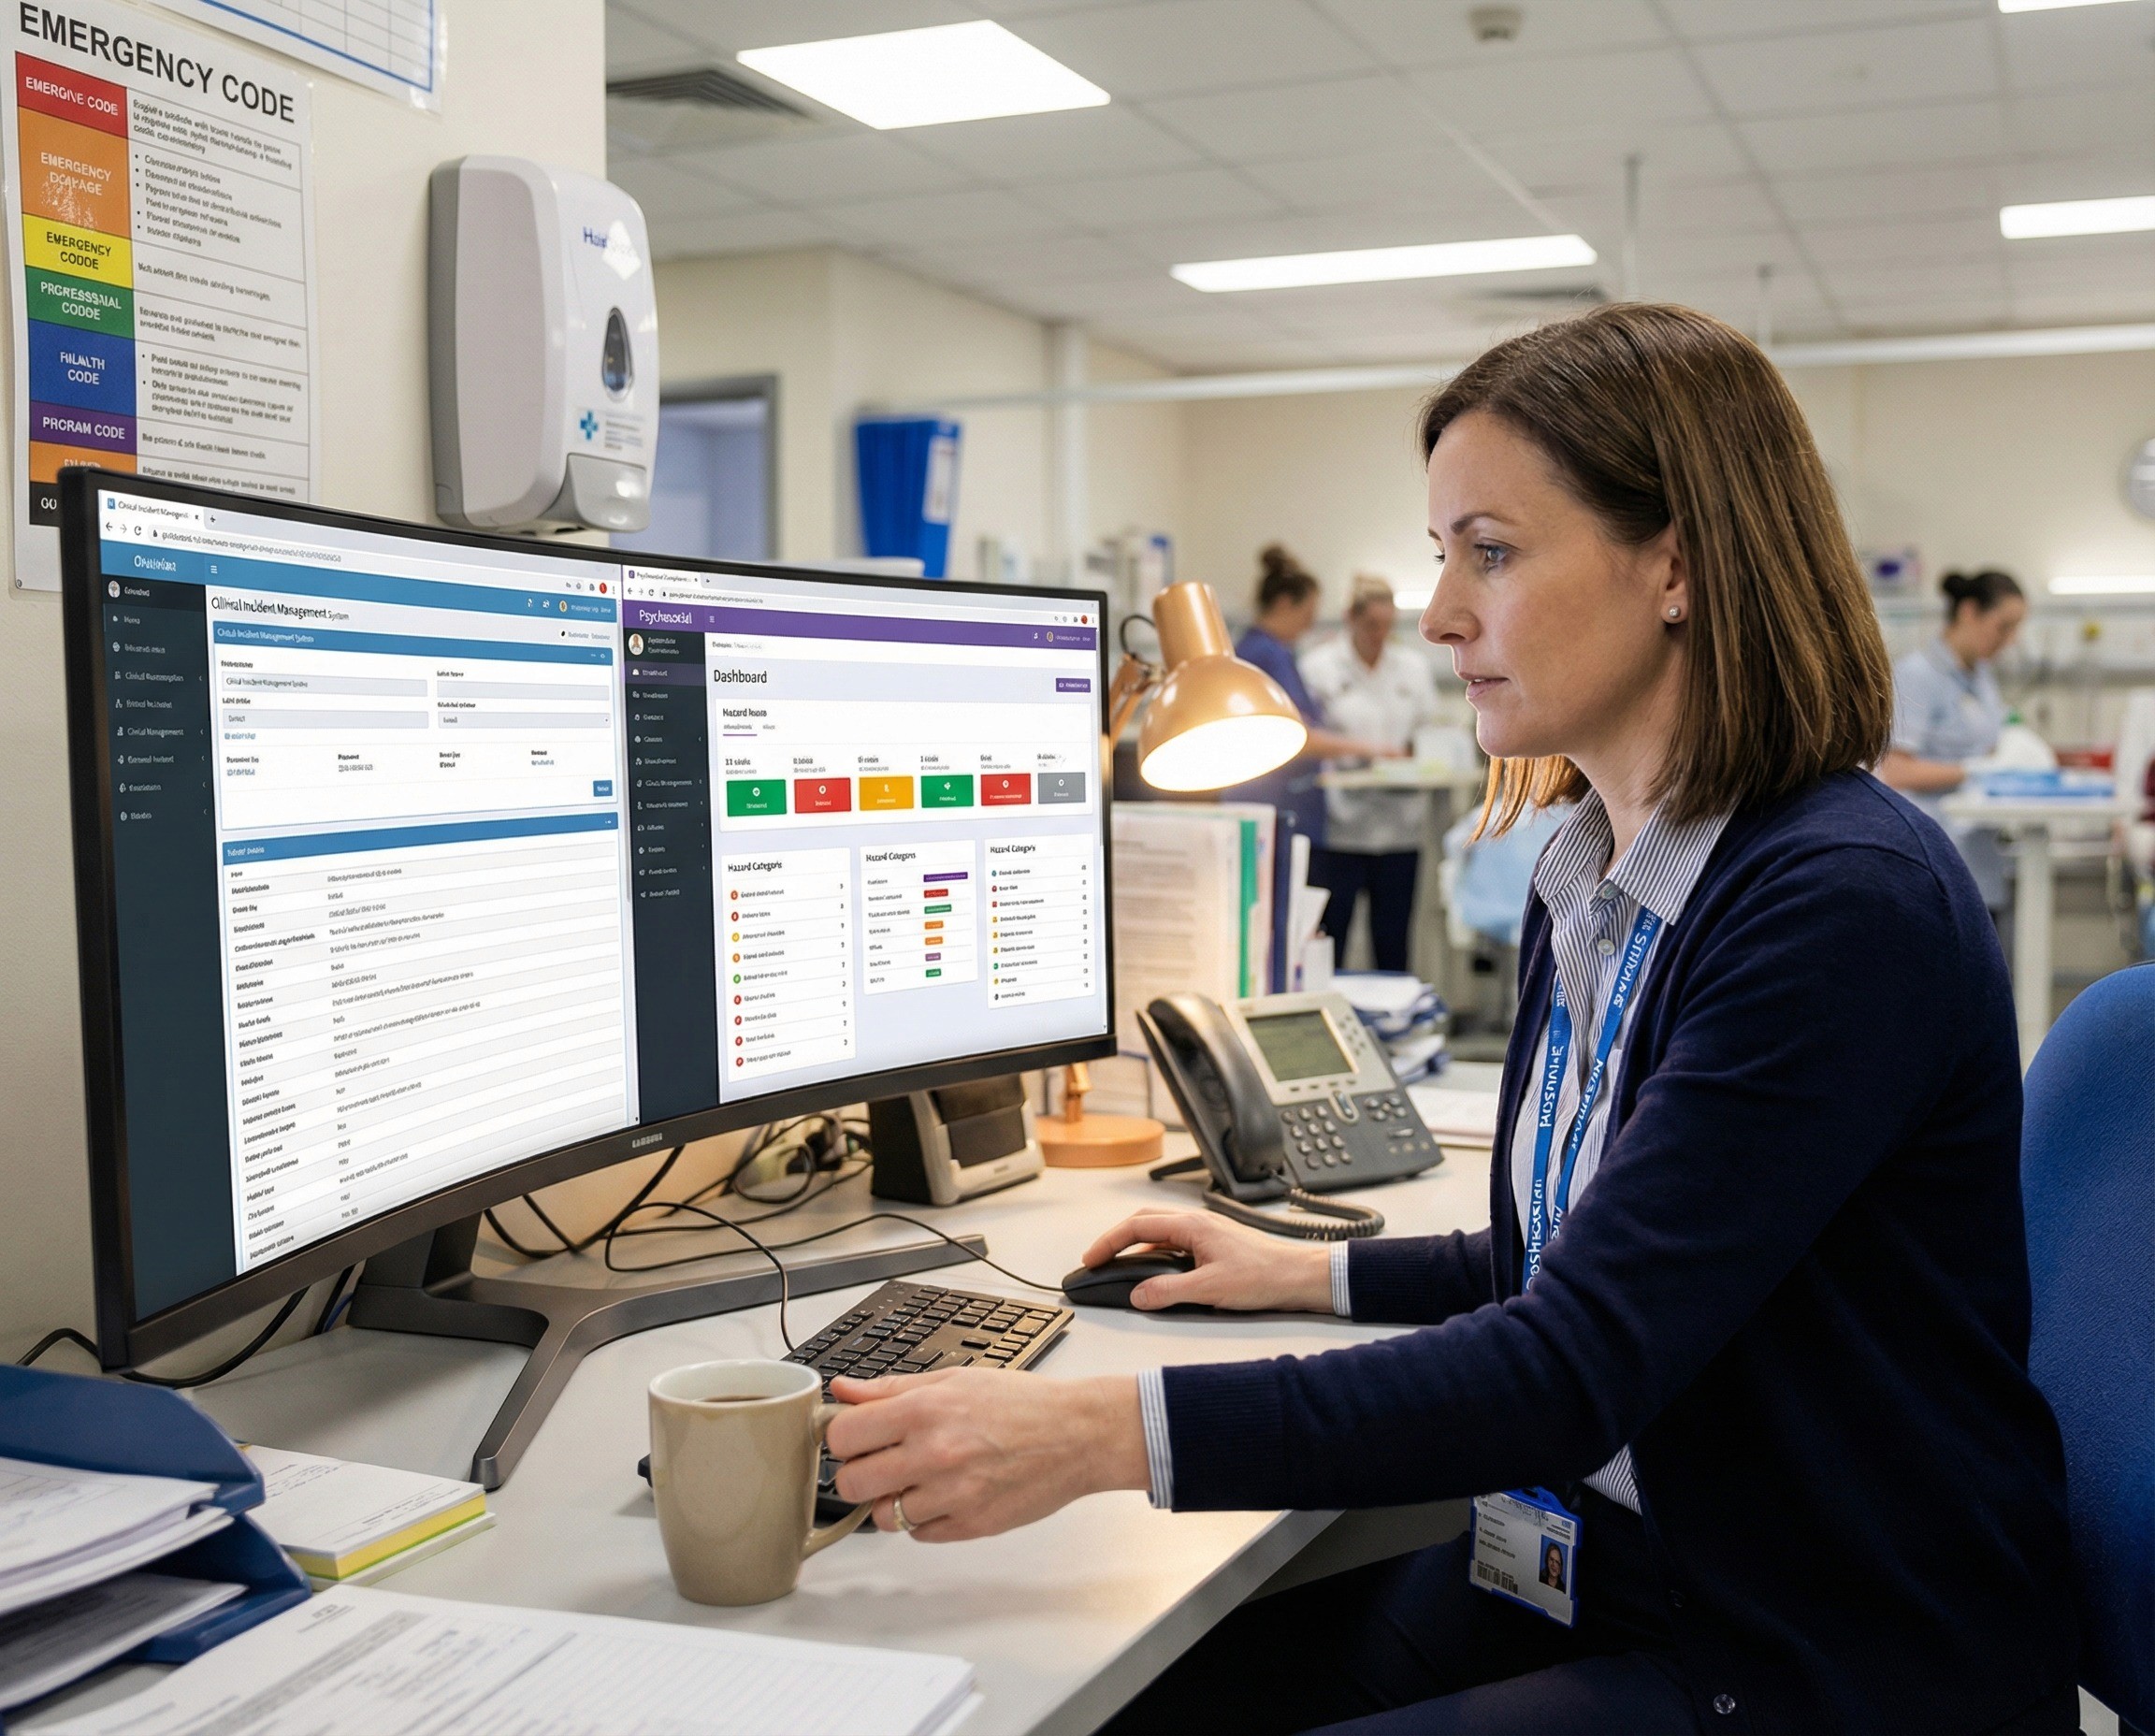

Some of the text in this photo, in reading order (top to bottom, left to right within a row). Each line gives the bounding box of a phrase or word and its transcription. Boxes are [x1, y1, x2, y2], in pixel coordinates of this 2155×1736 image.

[20, 1, 295, 123] EMERGENCY CODE
[87, 95, 119, 116] CODE
[40, 152, 111, 181] EMERGENCY
[67, 369, 100, 385] CODE
[94, 424, 125, 440] CODE
[714, 669, 767, 684] Dashboard
